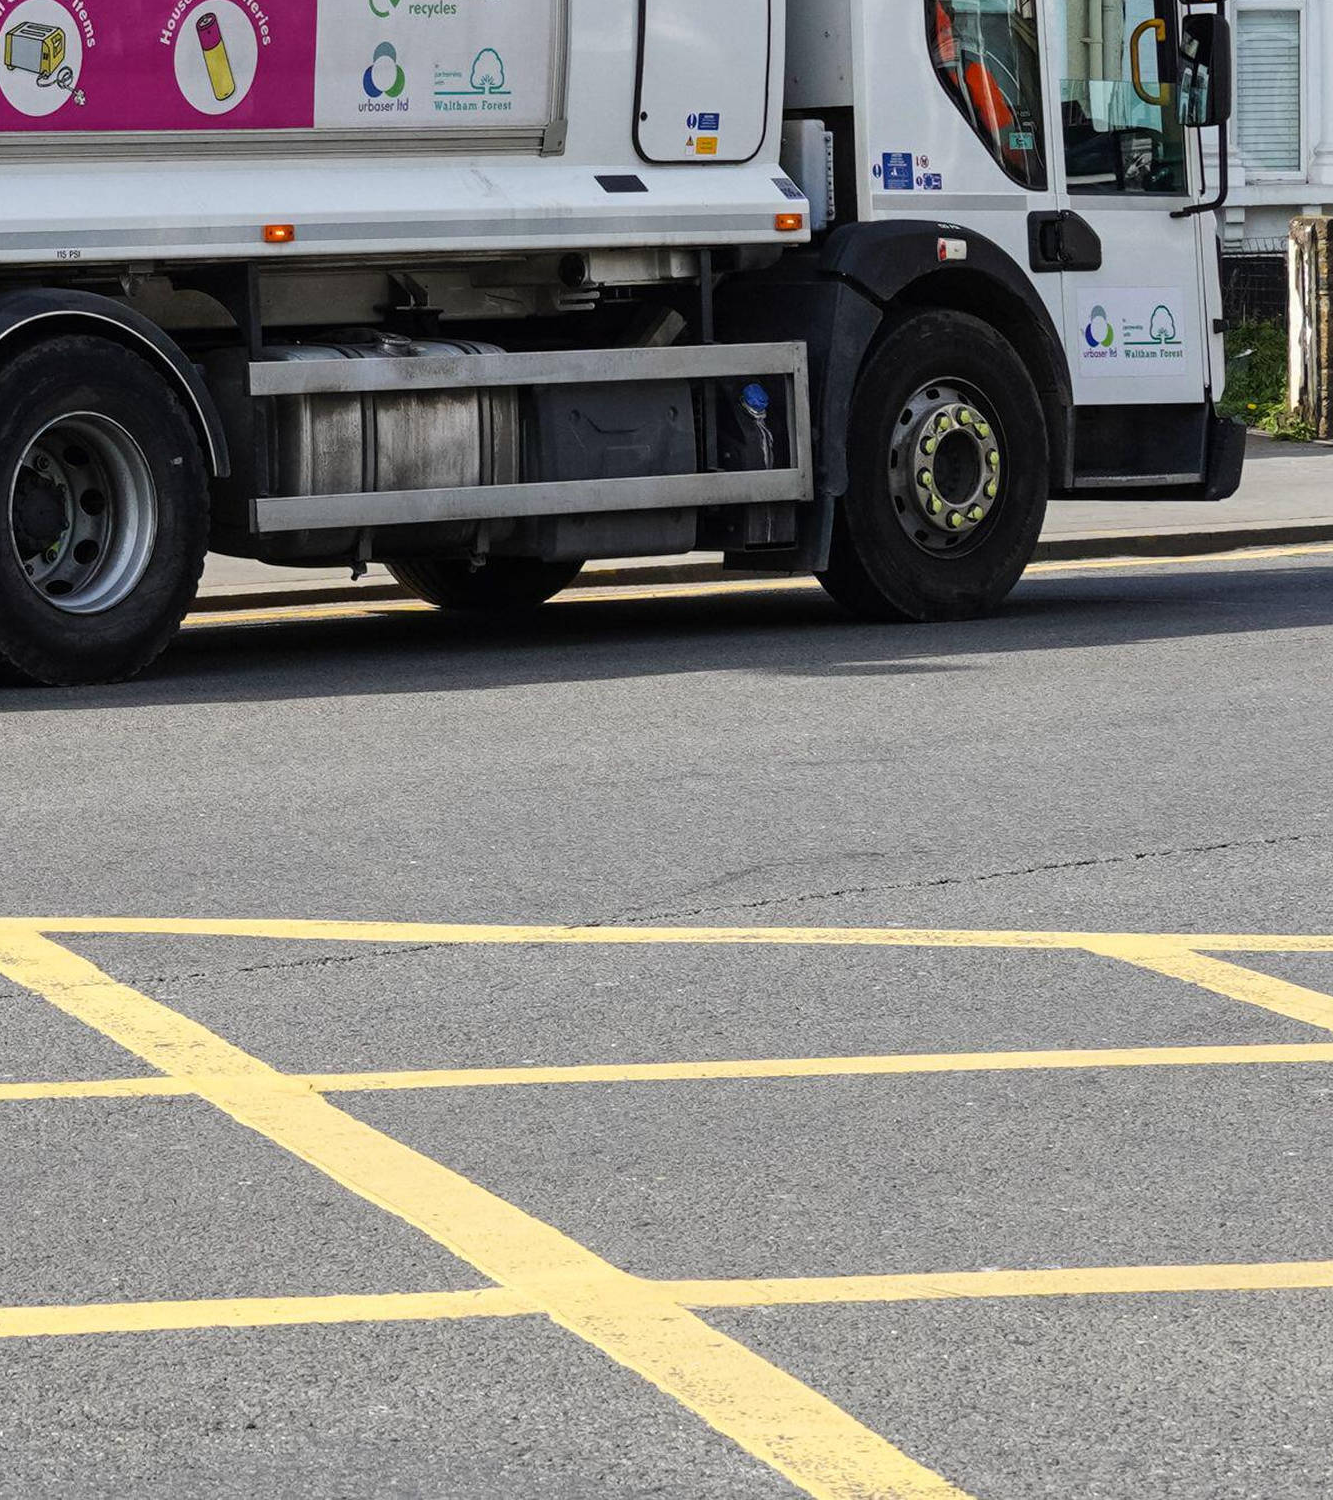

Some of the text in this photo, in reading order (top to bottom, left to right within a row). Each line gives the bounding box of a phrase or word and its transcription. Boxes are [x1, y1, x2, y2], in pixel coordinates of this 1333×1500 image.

[408, 0, 457, 18] recycles
[358, 97, 410, 112] urbaser ltd
[433, 100, 512, 111] Waltham Forest
[1124, 349, 1183, 359] Waltham Forest
